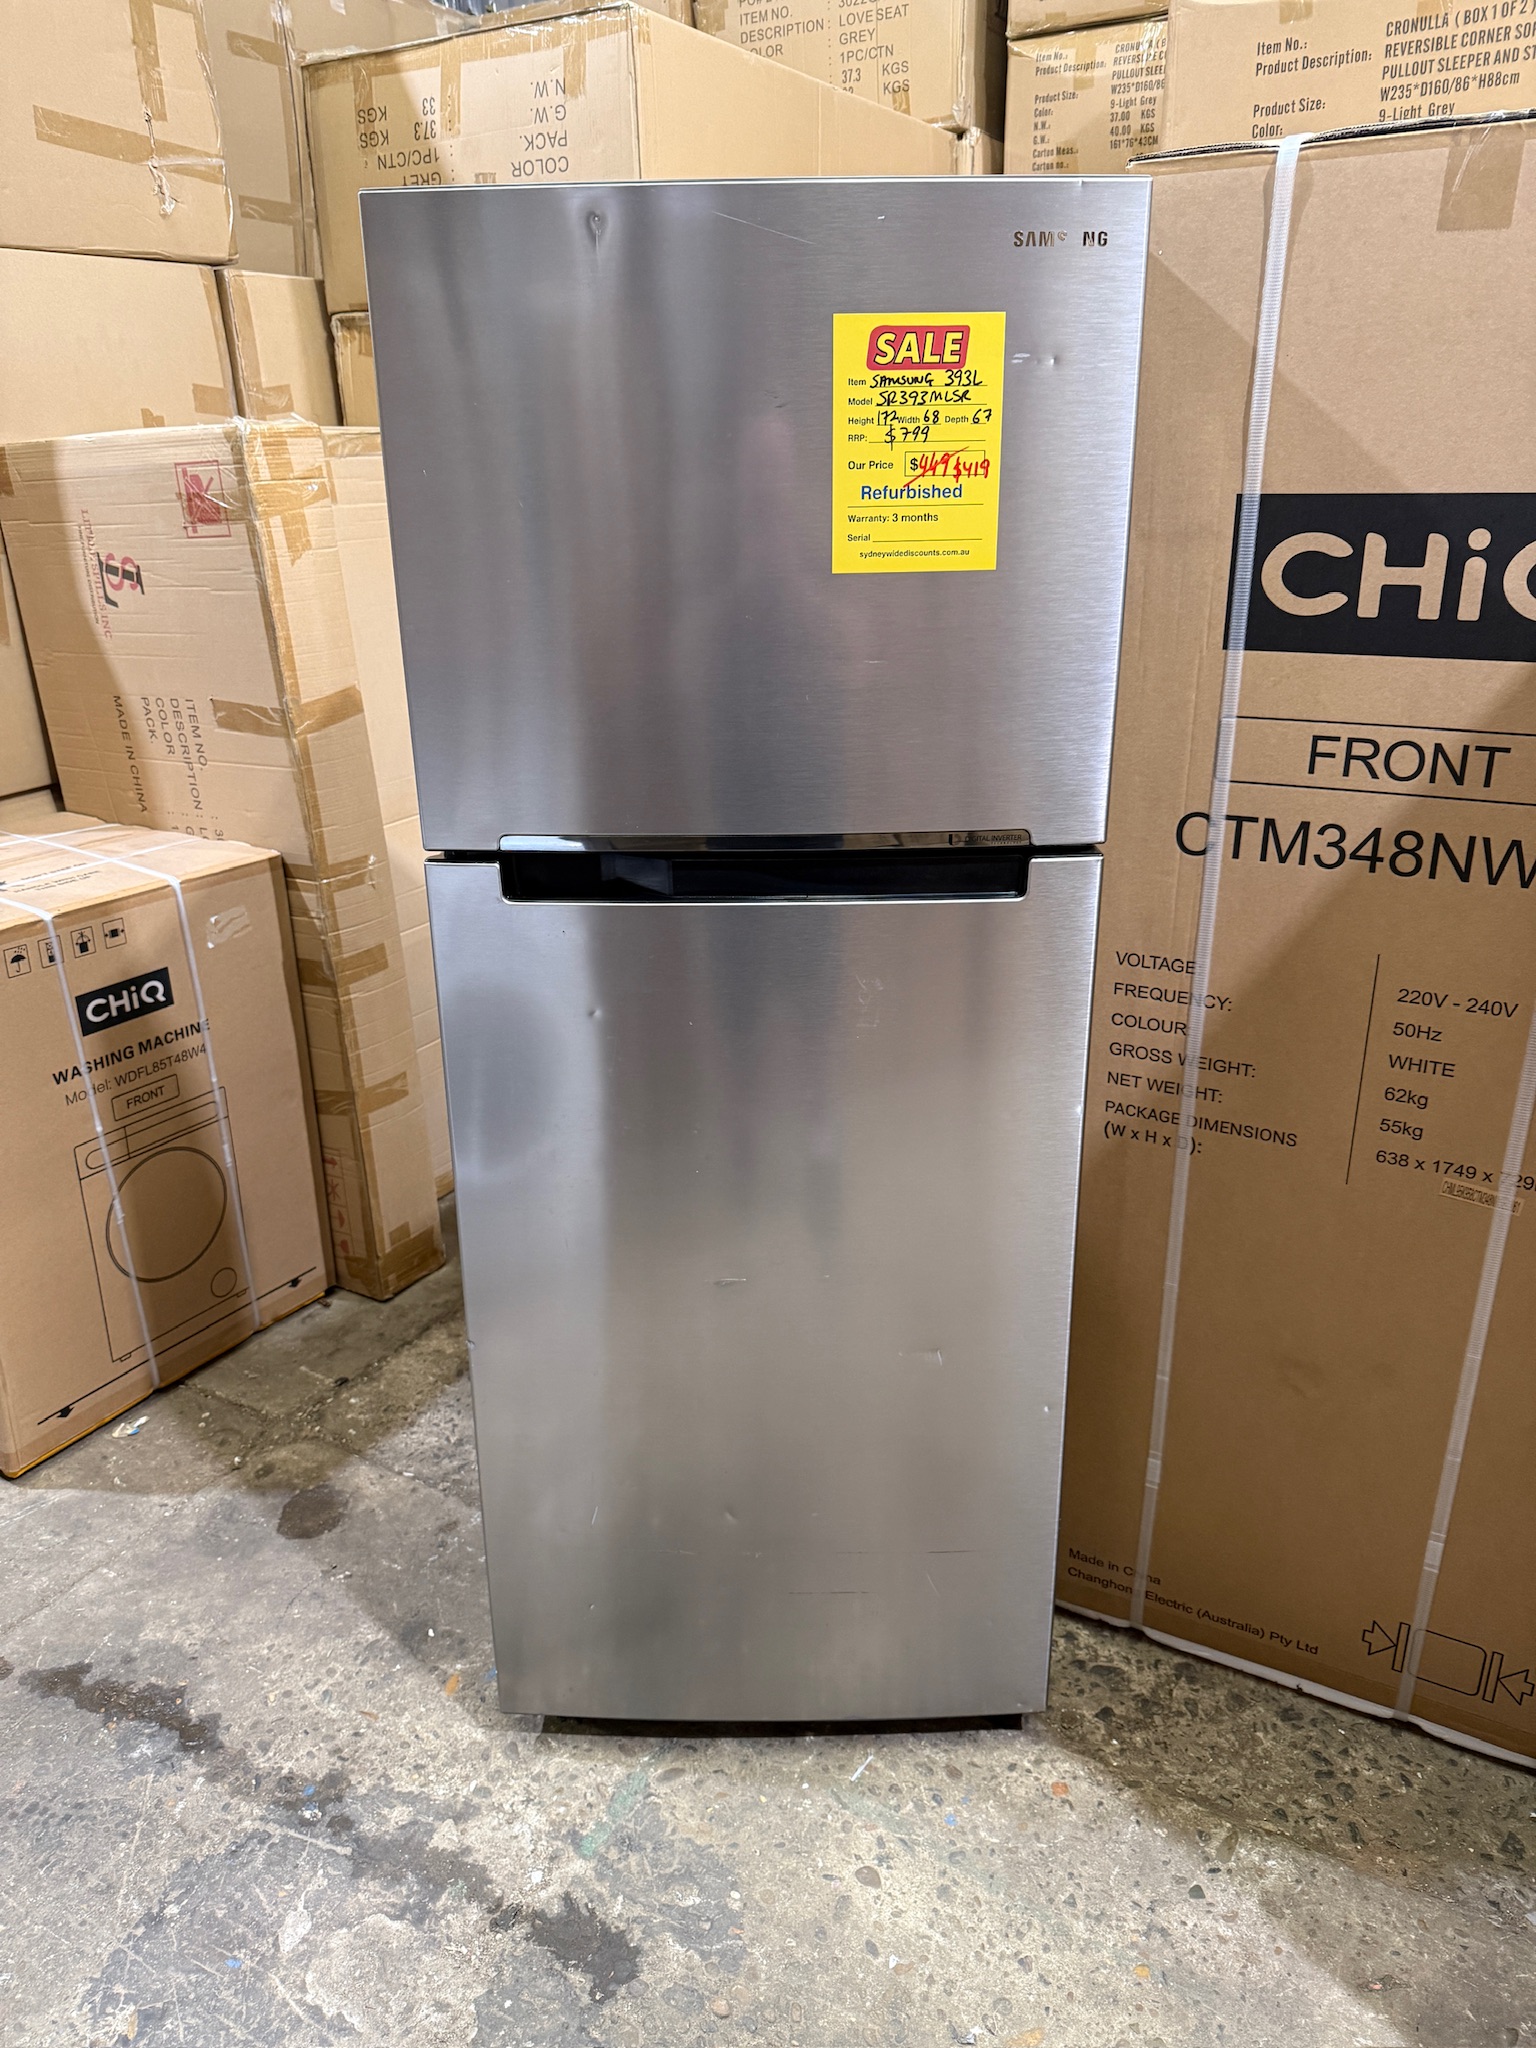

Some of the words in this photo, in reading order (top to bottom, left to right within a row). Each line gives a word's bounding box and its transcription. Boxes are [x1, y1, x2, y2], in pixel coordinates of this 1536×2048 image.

[740, 11, 768, 26] ITEM
[771, 5, 793, 20] NO.
[839, 12, 874, 28] LOVE
[876, 4, 910, 22] SEAT
[1386, 13, 1449, 37] CRONULLA
[1463, 5, 1488, 26] BOX
[1492, 3, 1498, 20] 1
[1501, 0, 1517, 18] OF
[740, 18, 824, 44] DESCRIPTION
[839, 28, 876, 45] GREY
[1257, 41, 1281, 56] Item
[1285, 37, 1307, 52] No.:
[1385, 34, 1458, 59] REVERSIBLE
[1461, 25, 1511, 48] CORNER
[840, 45, 894, 64] 1PC/CTN
[1036, 52, 1052, 63] Item
[1255, 57, 1298, 77] Product
[1302, 48, 1372, 71] Description:
[1382, 59, 1435, 80] PULLOUT
[1437, 51, 1491, 73] SLEEPER
[1494, 47, 1519, 65] AND
[842, 68, 861, 83] 37.3
[882, 60, 909, 77] KGS
[1035, 65, 1062, 76] Product
[1112, 67, 1143, 80] PULLOUT
[530, 78, 566, 98] N.W.
[883, 79, 910, 95] KGS
[1034, 93, 1061, 105] Product
[1061, 90, 1078, 100] Size:
[422, 97, 436, 116] 33
[1140, 95, 1157, 107] Grey
[1253, 101, 1296, 118] Product
[1299, 97, 1326, 111] Size:
[358, 106, 387, 124] KGS
[530, 104, 567, 124] G.W.
[1034, 108, 1053, 118] Color:
[1110, 111, 1130, 123] 37.00
[1141, 108, 1156, 119] KGS
[360, 129, 389, 148] KGS
[414, 120, 436, 140] 37.3
[1110, 125, 1131, 136] 40.00
[1140, 122, 1155, 133] KGS
[1252, 123, 1283, 139] Color:
[519, 130, 567, 151] PACK.
[378, 147, 440, 170] 1PC/CTN
[1032, 148, 1054, 159] Carton
[511, 156, 569, 177] COLOR
[1032, 161, 1054, 172] Carton
[873, 330, 964, 366] SALE
[848, 378, 866, 386] Item
[869, 372, 934, 388] SAMSUNG
[944, 369, 983, 387] 393L
[848, 398, 872, 406] Model
[848, 416, 874, 426] Height
[898, 415, 920, 424] Width
[923, 409, 940, 424] 68
[945, 415, 969, 425] Depth
[972, 408, 993, 424] 67
[848, 434, 867, 442] RRP:
[848, 460, 865, 470] Our
[869, 460, 894, 470] Price
[861, 484, 963, 500] Refurbished
[848, 514, 889, 523] Warranty:
[892, 513, 898, 522] 3
[901, 513, 939, 522] months
[848, 534, 870, 542] Serial
[860, 549, 970, 558] sydneywidediscounts.com.au
[113, 695, 131, 741] MADE
[141, 697, 158, 744] PACK.
[155, 697, 176, 755] COLOR
[185, 699, 201, 738] ITEM
[195, 743, 208, 771] NO.
[125, 745, 136, 761] IN
[169, 698, 203, 810] DESCRIPTION
[1307, 734, 1512, 788] FRONT
[130, 765, 148, 813] CHINA
[86, 980, 167, 1022] CHiQ
[1396, 987, 1448, 1010] 220V
[1465, 997, 1519, 1019] 240V
[1393, 1021, 1443, 1043] 50Hz
[1109, 1042, 1172, 1064] GROSS
[52, 1045, 135, 1086] WASHING
[1388, 1053, 1455, 1078] WHITE
[1107, 1071, 1142, 1088] NET
[126, 1085, 165, 1109] FRONT
[1384, 1086, 1429, 1110] 62kg
[1105, 1100, 1180, 1125] PACKAGE
[1104, 1120, 1126, 1138] (W
[1131, 1128, 1139, 1140] x
[1145, 1130, 1157, 1143] H
[1163, 1136, 1171, 1147] x
[1379, 1118, 1424, 1141] 55kg
[1376, 1150, 1409, 1167] 638
[1414, 1159, 1426, 1171] x
[1432, 1160, 1477, 1179] 1749
[1482, 1171, 1494, 1183] x
[1068, 1547, 1104, 1568] Made
[1108, 1560, 1119, 1573] in
[1067, 1566, 1138, 1595] Changhon
[1145, 1590, 1193, 1615] Electric
[1197, 1608, 1265, 1640] (Australia)
[1269, 1631, 1292, 1648] Pty
[1297, 1640, 1318, 1655] Ltd
